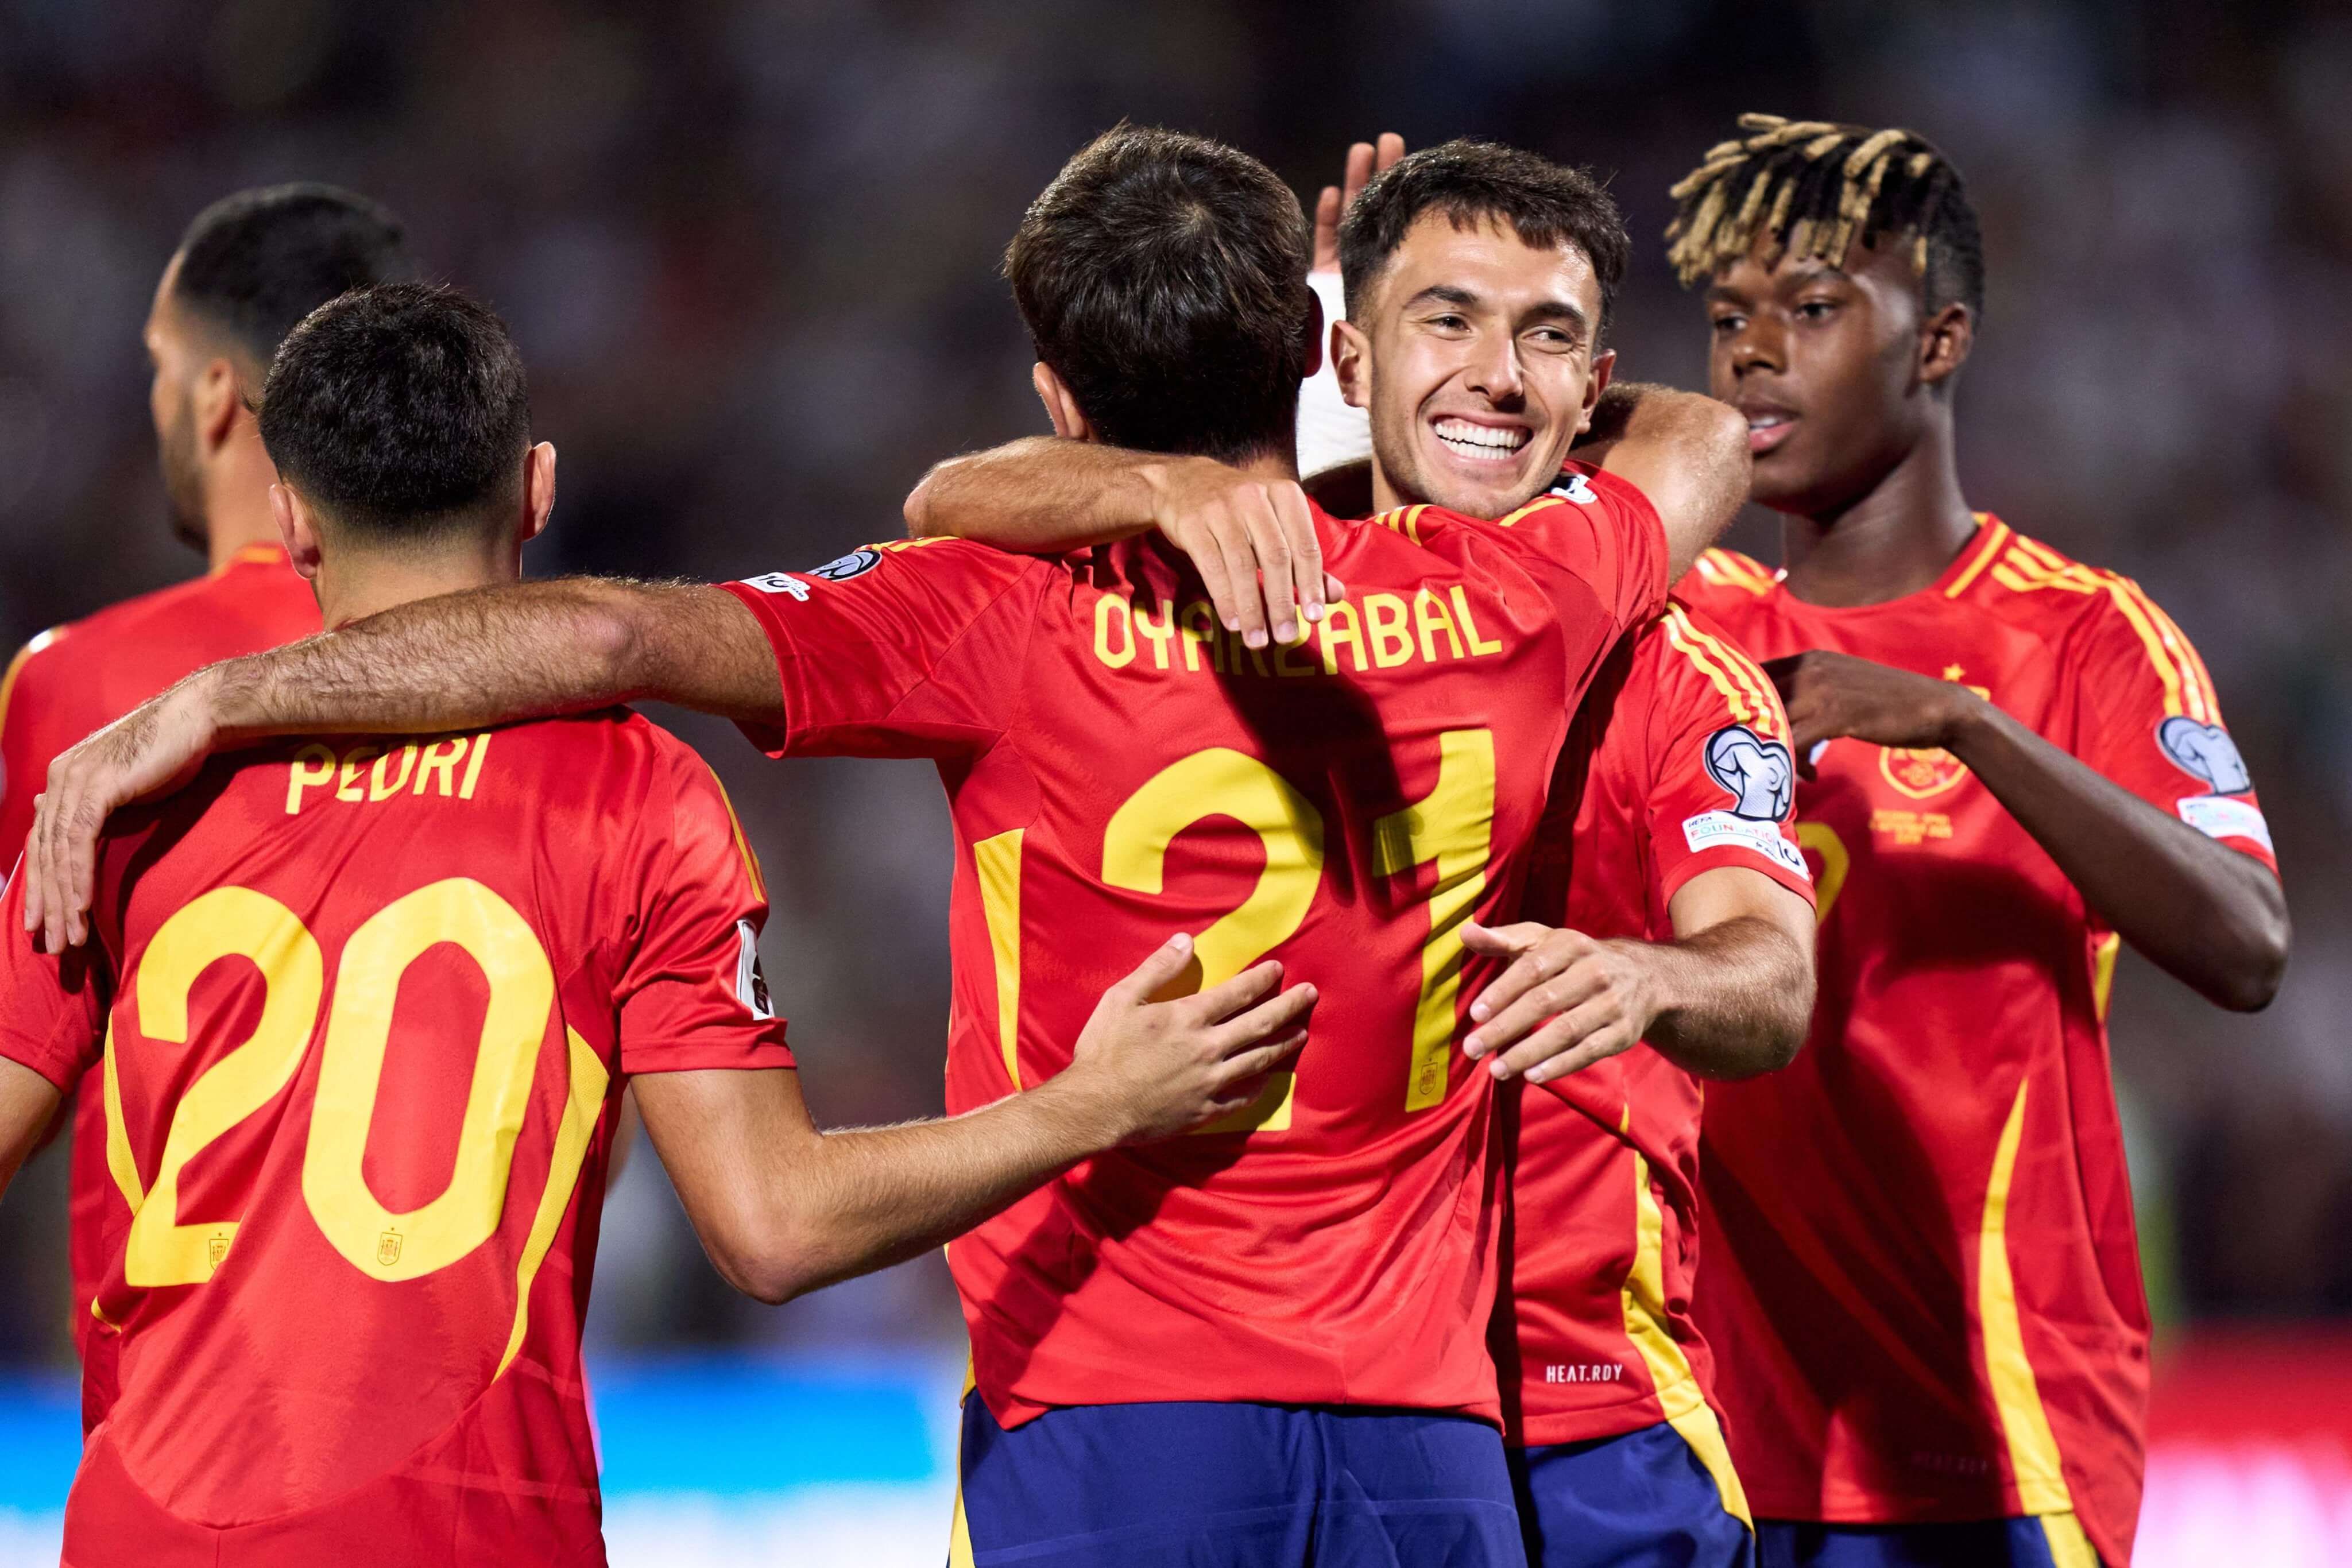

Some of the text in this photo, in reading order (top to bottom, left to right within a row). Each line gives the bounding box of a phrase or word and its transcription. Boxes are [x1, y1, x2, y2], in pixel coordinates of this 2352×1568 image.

[285, 733, 492, 815] PEDRI
[1690, 823, 1779, 844] FOUNATIO
[1101, 729, 1495, 1134] 21
[125, 877, 555, 1287] 20
[1546, 1364, 1623, 1383] HEAT.RDY
